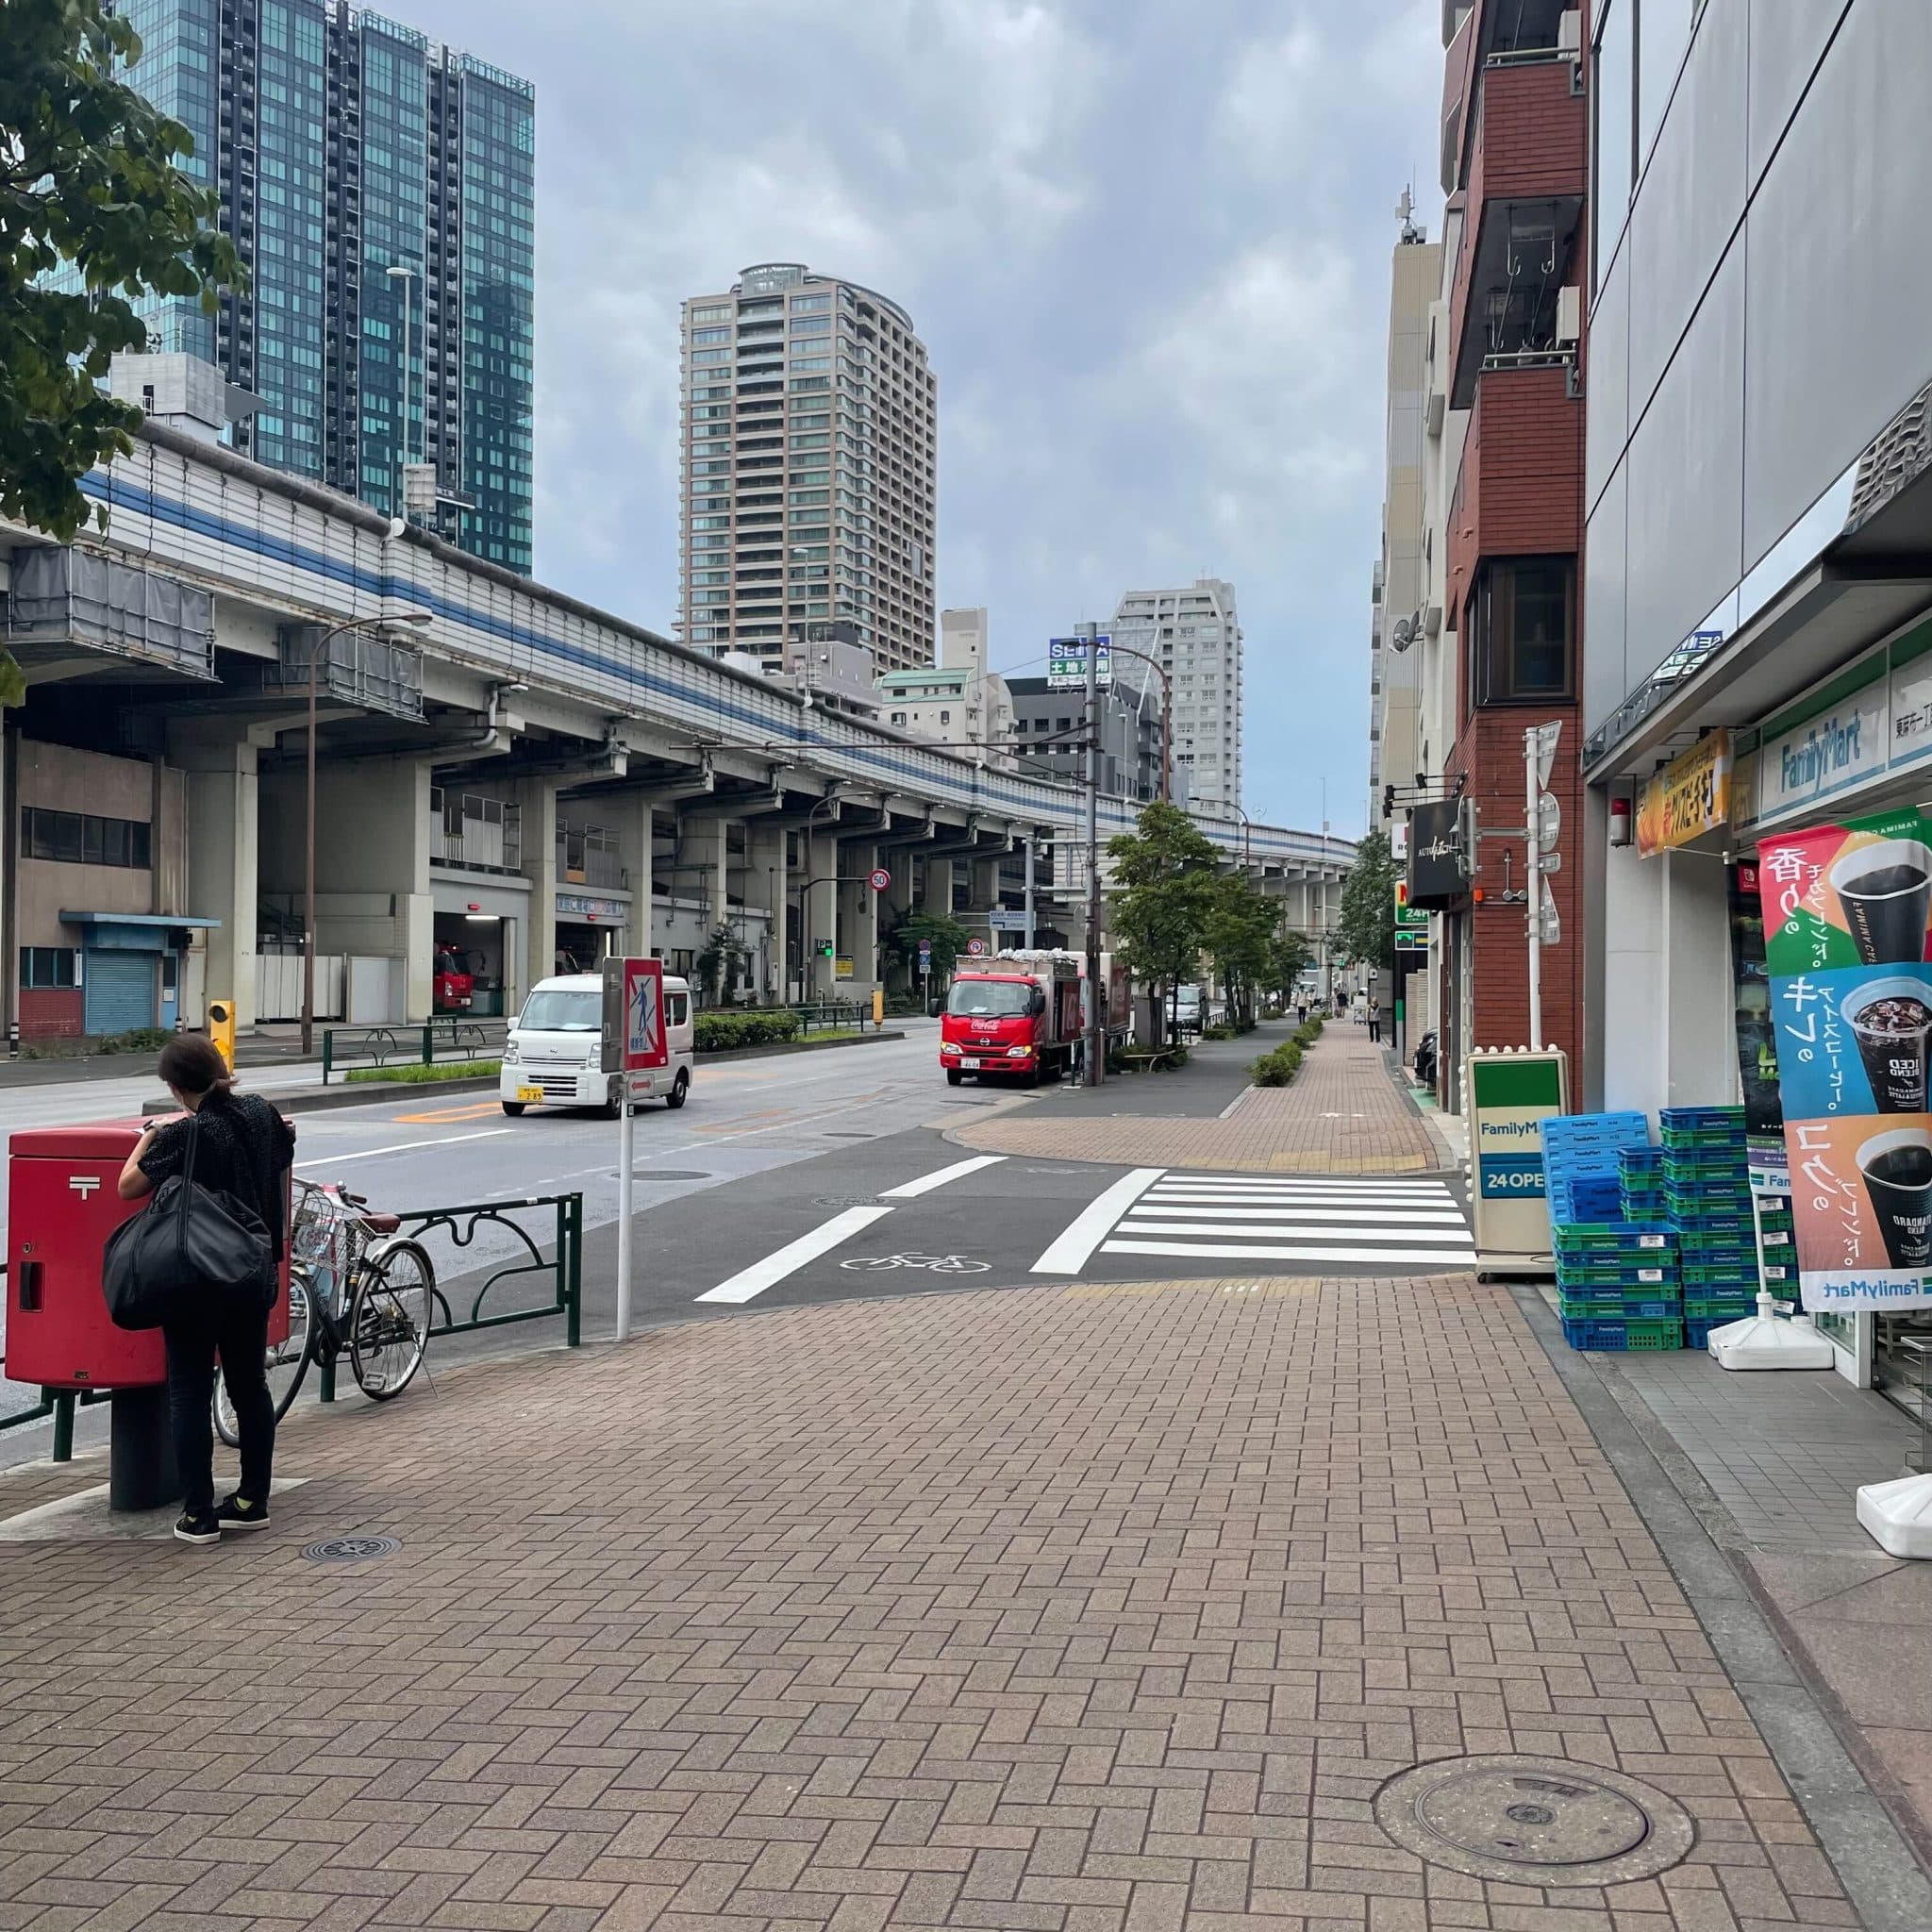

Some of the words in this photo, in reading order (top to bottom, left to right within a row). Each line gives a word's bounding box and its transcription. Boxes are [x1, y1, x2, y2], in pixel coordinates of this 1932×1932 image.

[1895, 702, 1932, 740] 東麻布一丁
[1781, 708, 1861, 794] FamilyMart
[874, 875, 885, 885] 50
[1481, 1122, 1541, 1138] FamilyM
[1488, 1174, 1507, 1188] 24
[1509, 1173, 1544, 1189] OPE
